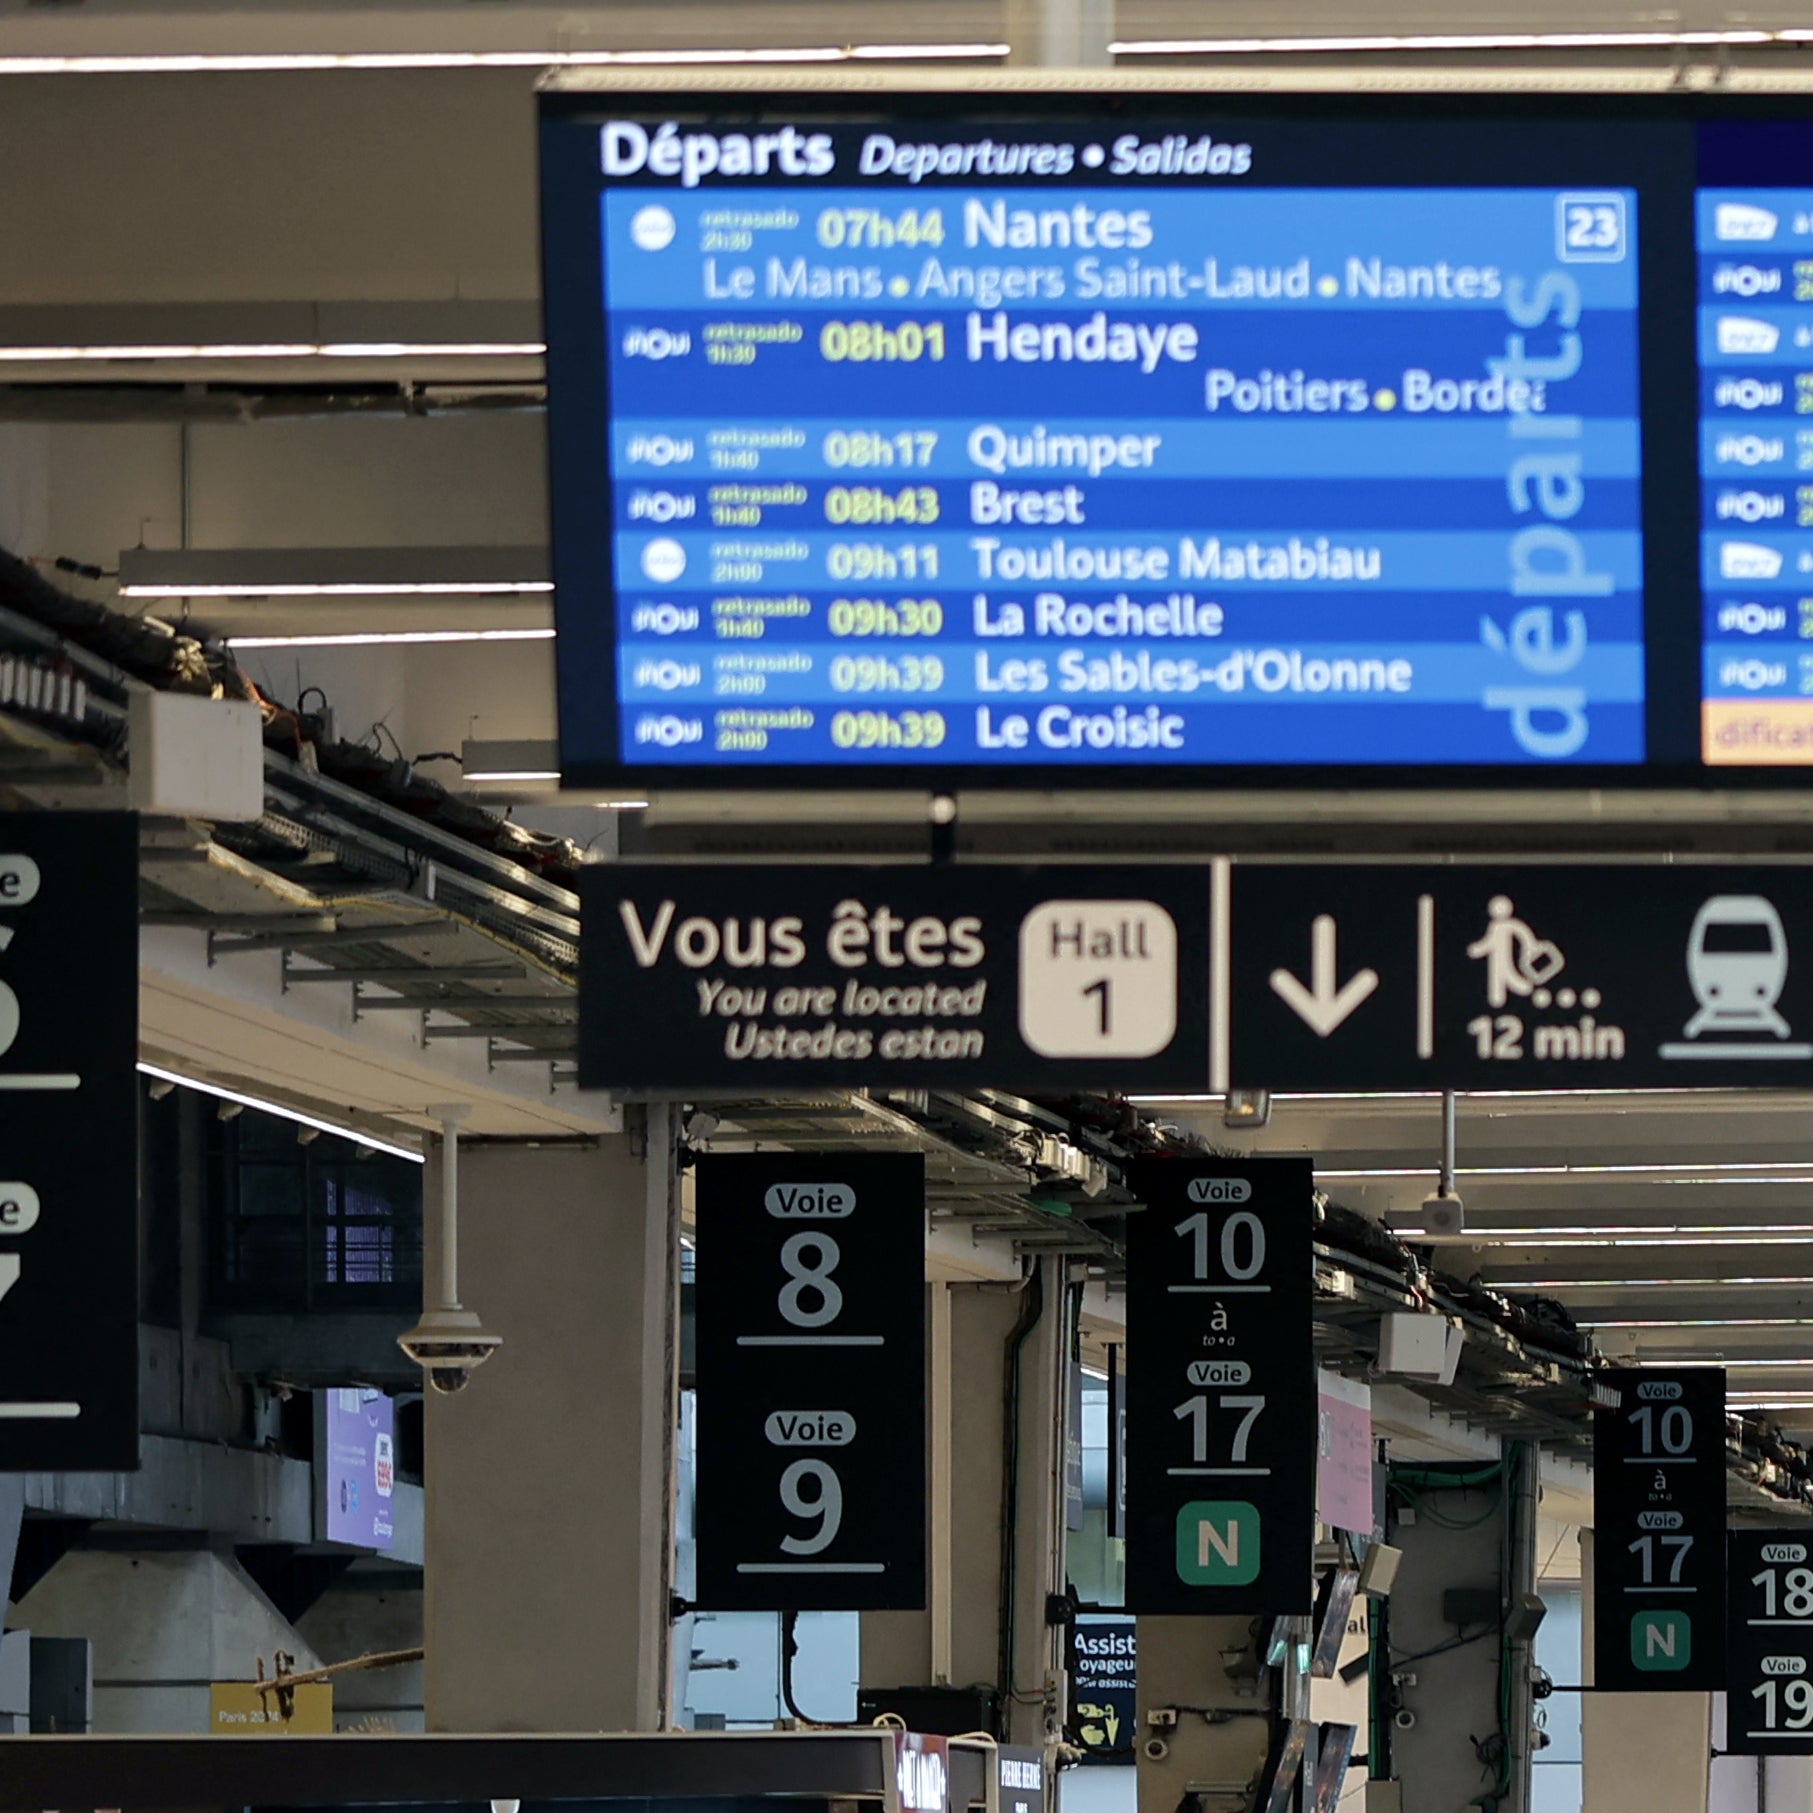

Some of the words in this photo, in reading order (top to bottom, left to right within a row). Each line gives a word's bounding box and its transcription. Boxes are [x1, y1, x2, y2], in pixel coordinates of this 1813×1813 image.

[601, 120, 835, 187] Départs
[860, 136, 1075, 183] Departures
[1110, 136, 1253, 175] Salidas
[817, 208, 945, 248] 07h44
[964, 198, 1153, 248] Nantes
[1566, 206, 1619, 248] 23
[703, 258, 754, 298] Le
[767, 258, 882, 298] Mans
[916, 256, 1065, 307] Angers
[1073, 256, 1310, 298] Saint-Laud
[1346, 258, 1501, 298] Nantes
[820, 322, 945, 362] 08h01
[967, 311, 1198, 374] Hendaye
[1204, 369, 1369, 411] Poitiers
[968, 426, 1161, 477] Quimper
[969, 481, 1085, 524] Brest
[1482, 268, 1616, 758] départs
[969, 536, 1168, 580] Toulouse
[1180, 536, 1381, 580] Matabiau
[973, 593, 1024, 637] La
[1035, 593, 1222, 638] Rochelle
[974, 650, 1048, 692] Les
[1057, 648, 1412, 694] Sables-d'Olonne
[975, 705, 1028, 748] Le
[1037, 704, 1184, 748] Croisic
[618, 900, 805, 968] Vous
[827, 898, 985, 968] êtes
[1050, 921, 1149, 958] Hall
[696, 979, 764, 1017] You
[773, 984, 834, 1017] are
[843, 979, 987, 1017] located
[1082, 977, 1112, 1035] 1
[724, 1023, 871, 1059] Ustedes
[881, 1026, 983, 1059] estan
[1467, 1019, 1523, 1058] 12
[1535, 1017, 1625, 1058] min
[776, 1191, 842, 1212] Voie
[1174, 1212, 1266, 1280] 10
[778, 1231, 842, 1328] 8
[776, 1419, 842, 1440] Voie
[1173, 1395, 1265, 1462] 17
[779, 1458, 842, 1556] 9
[1198, 1519, 1238, 1566] N
